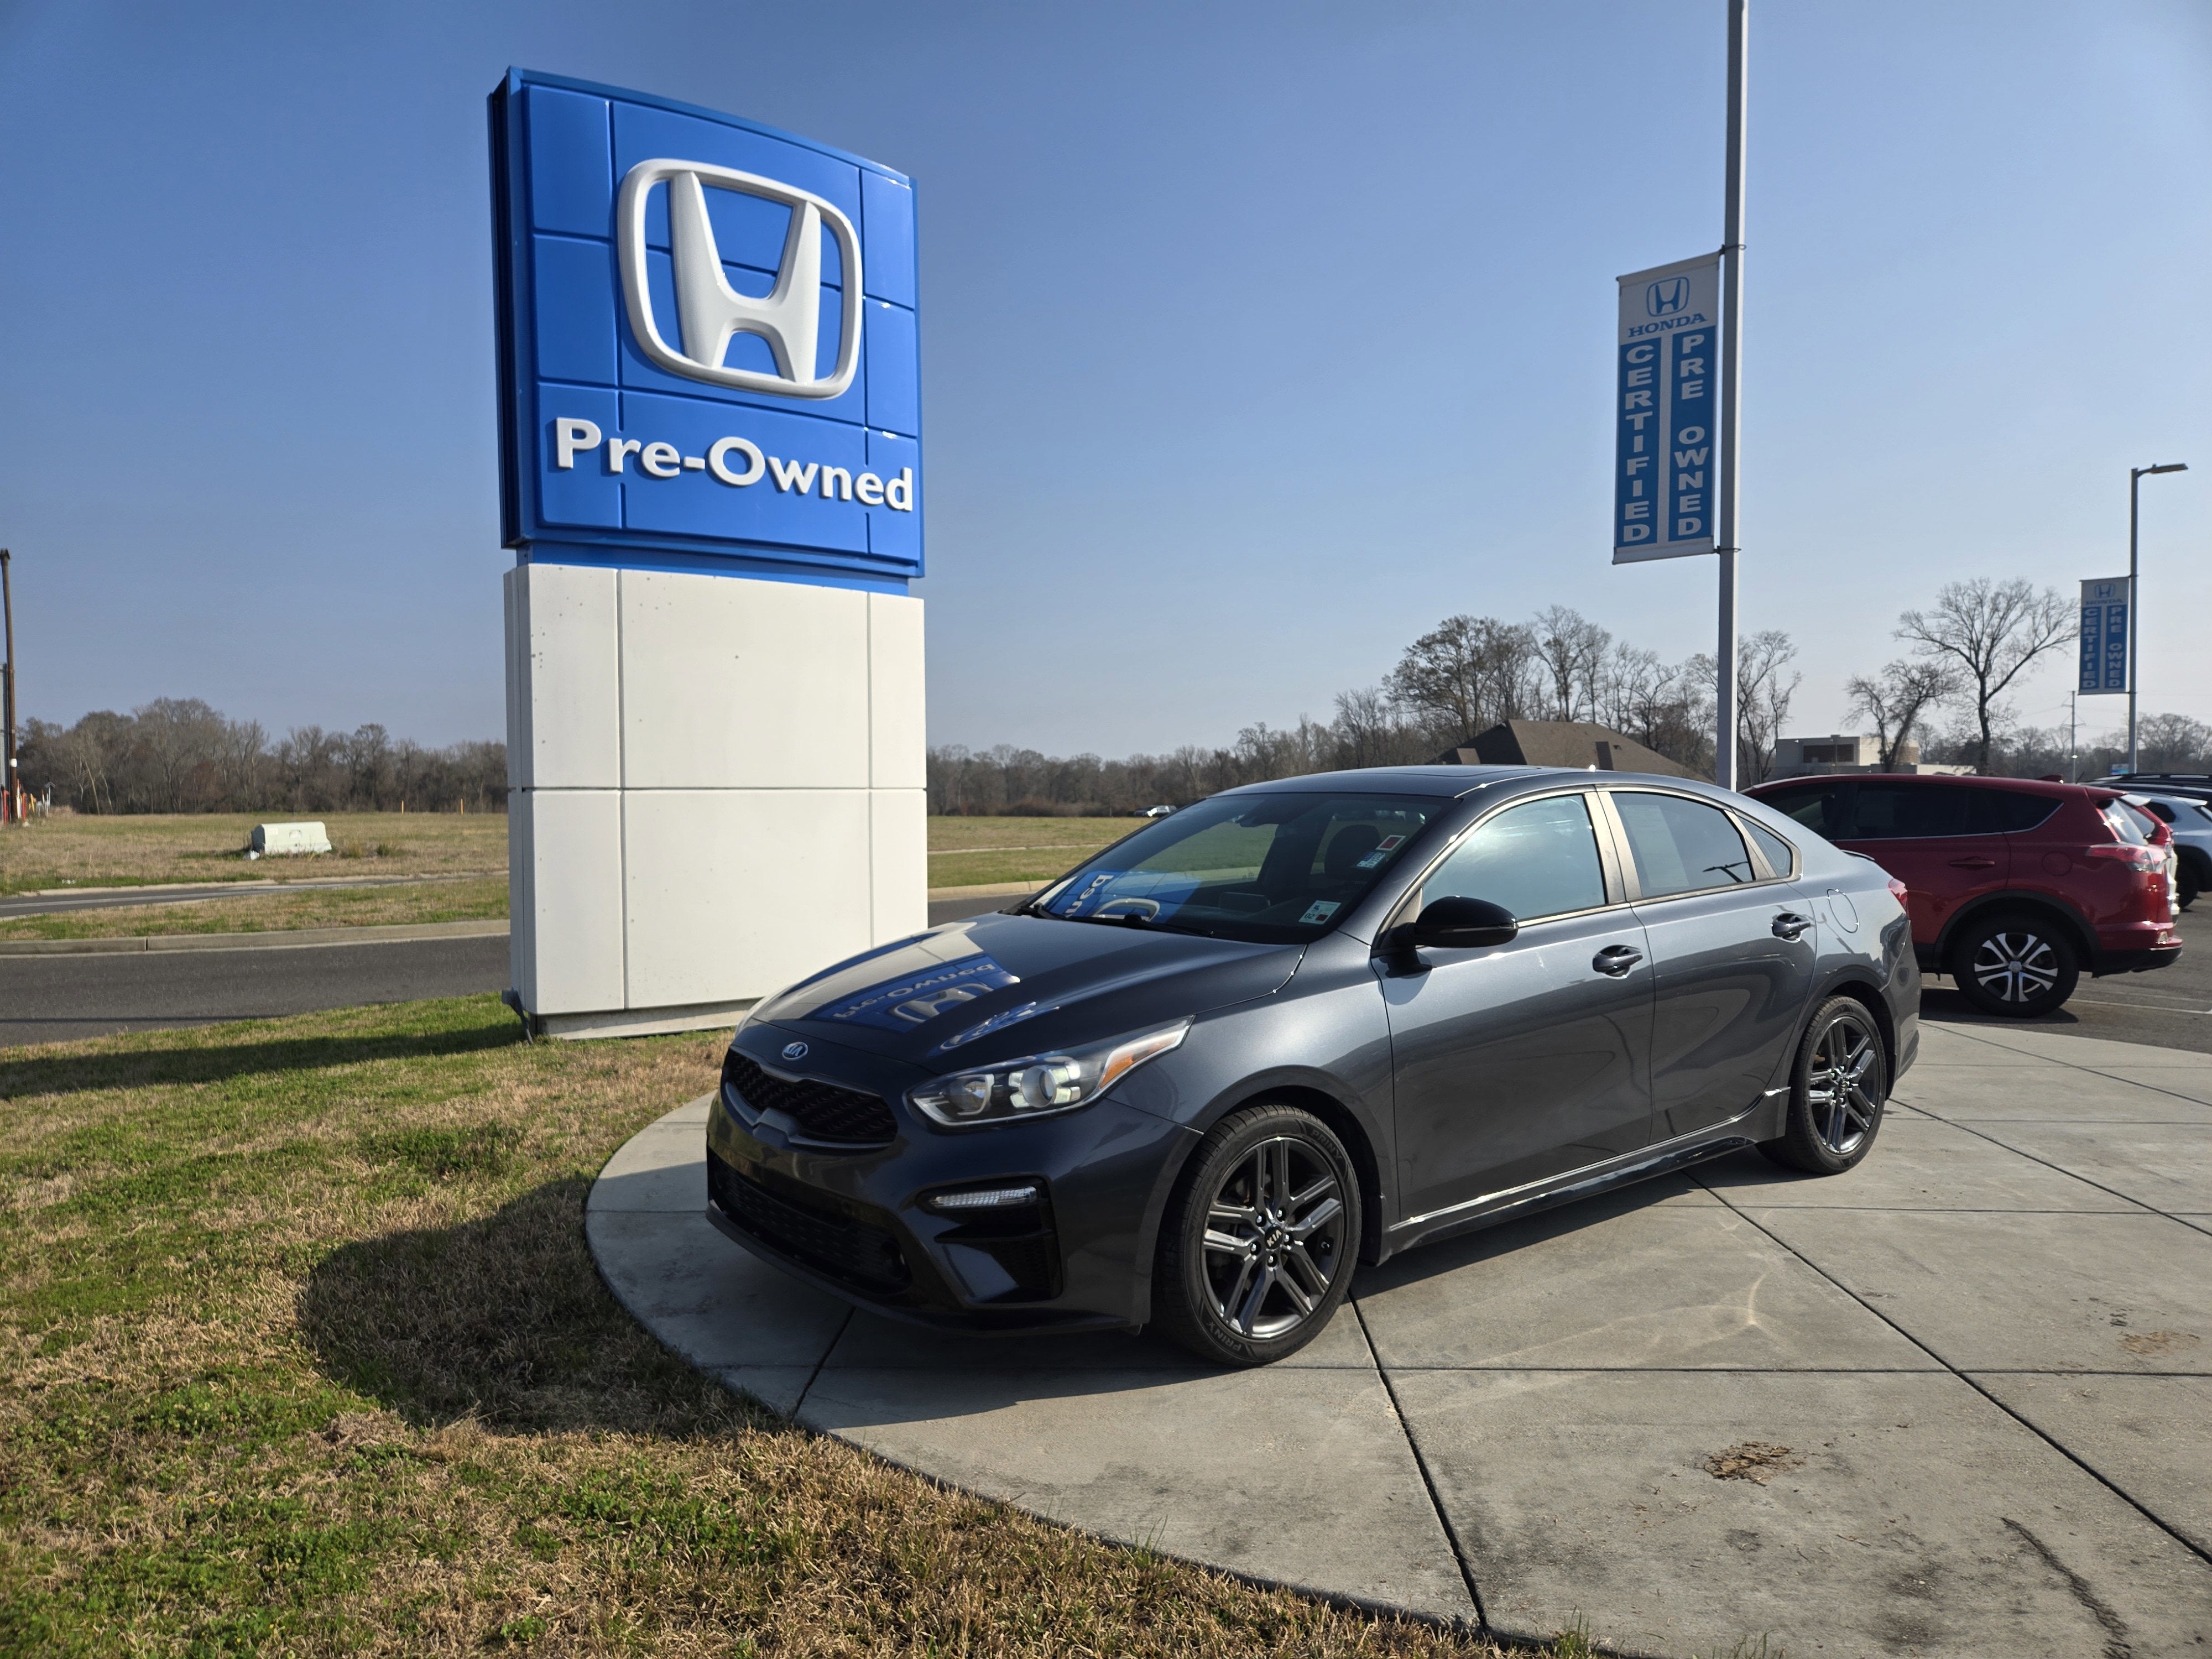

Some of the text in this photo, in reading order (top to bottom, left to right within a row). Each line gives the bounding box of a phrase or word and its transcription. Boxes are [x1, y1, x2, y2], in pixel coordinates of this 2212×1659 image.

[1628, 312, 1708, 337] HONDA
[556, 417, 913, 512] Pre-Owned
[1624, 345, 1655, 542] CERTIFIED
[1674, 335, 1709, 536] PRE OWNED
[2083, 608, 2098, 688] CERTIFIED
[2107, 607, 2124, 687] PRE OWNED
[1266, 1229, 1282, 1247] KIA
